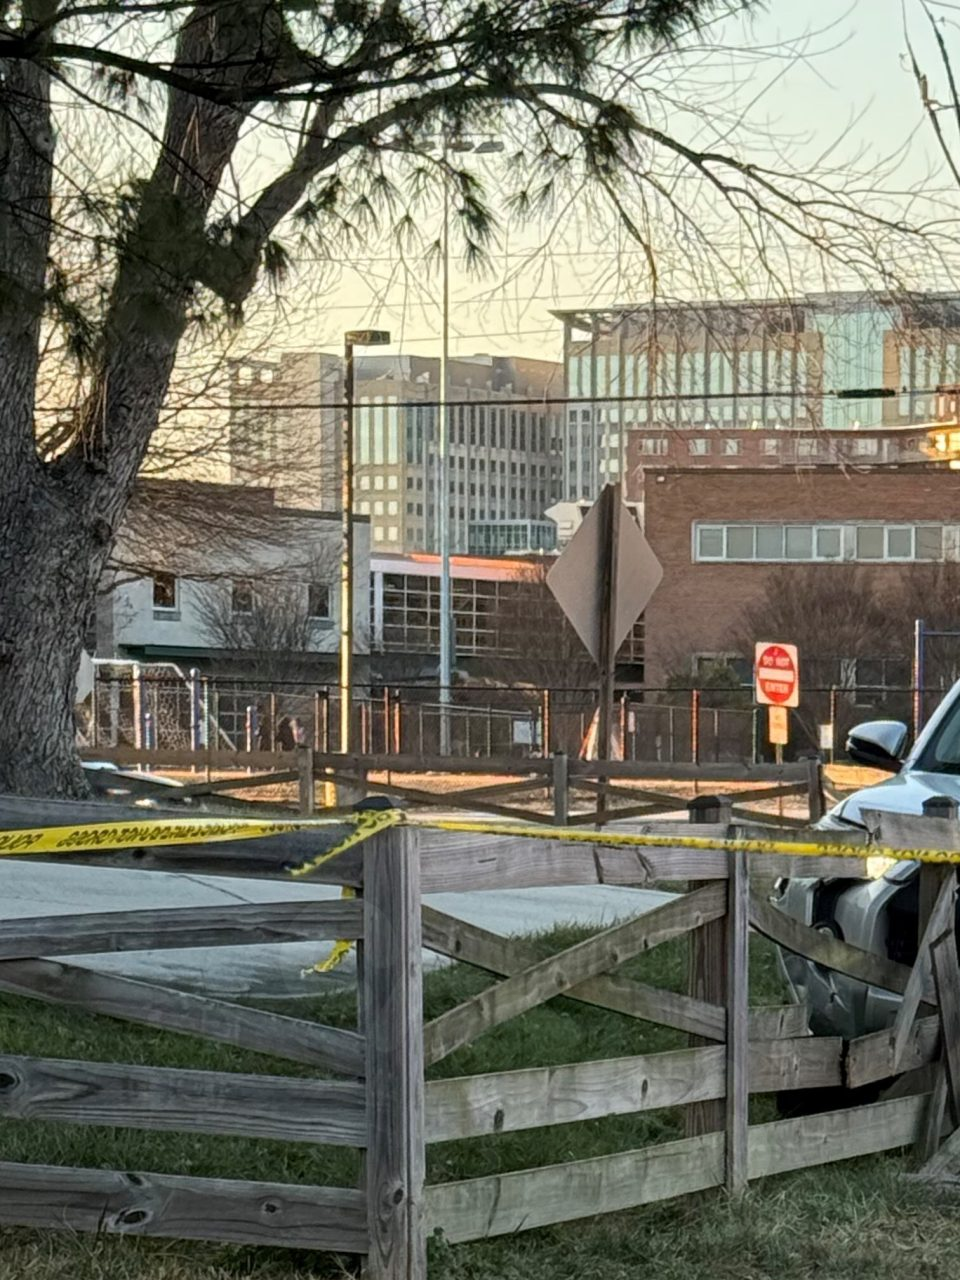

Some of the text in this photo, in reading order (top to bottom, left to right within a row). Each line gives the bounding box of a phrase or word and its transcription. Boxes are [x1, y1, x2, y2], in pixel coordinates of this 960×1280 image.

[763, 656, 790, 667] DO NOT
[764, 682, 789, 694] ENTER
